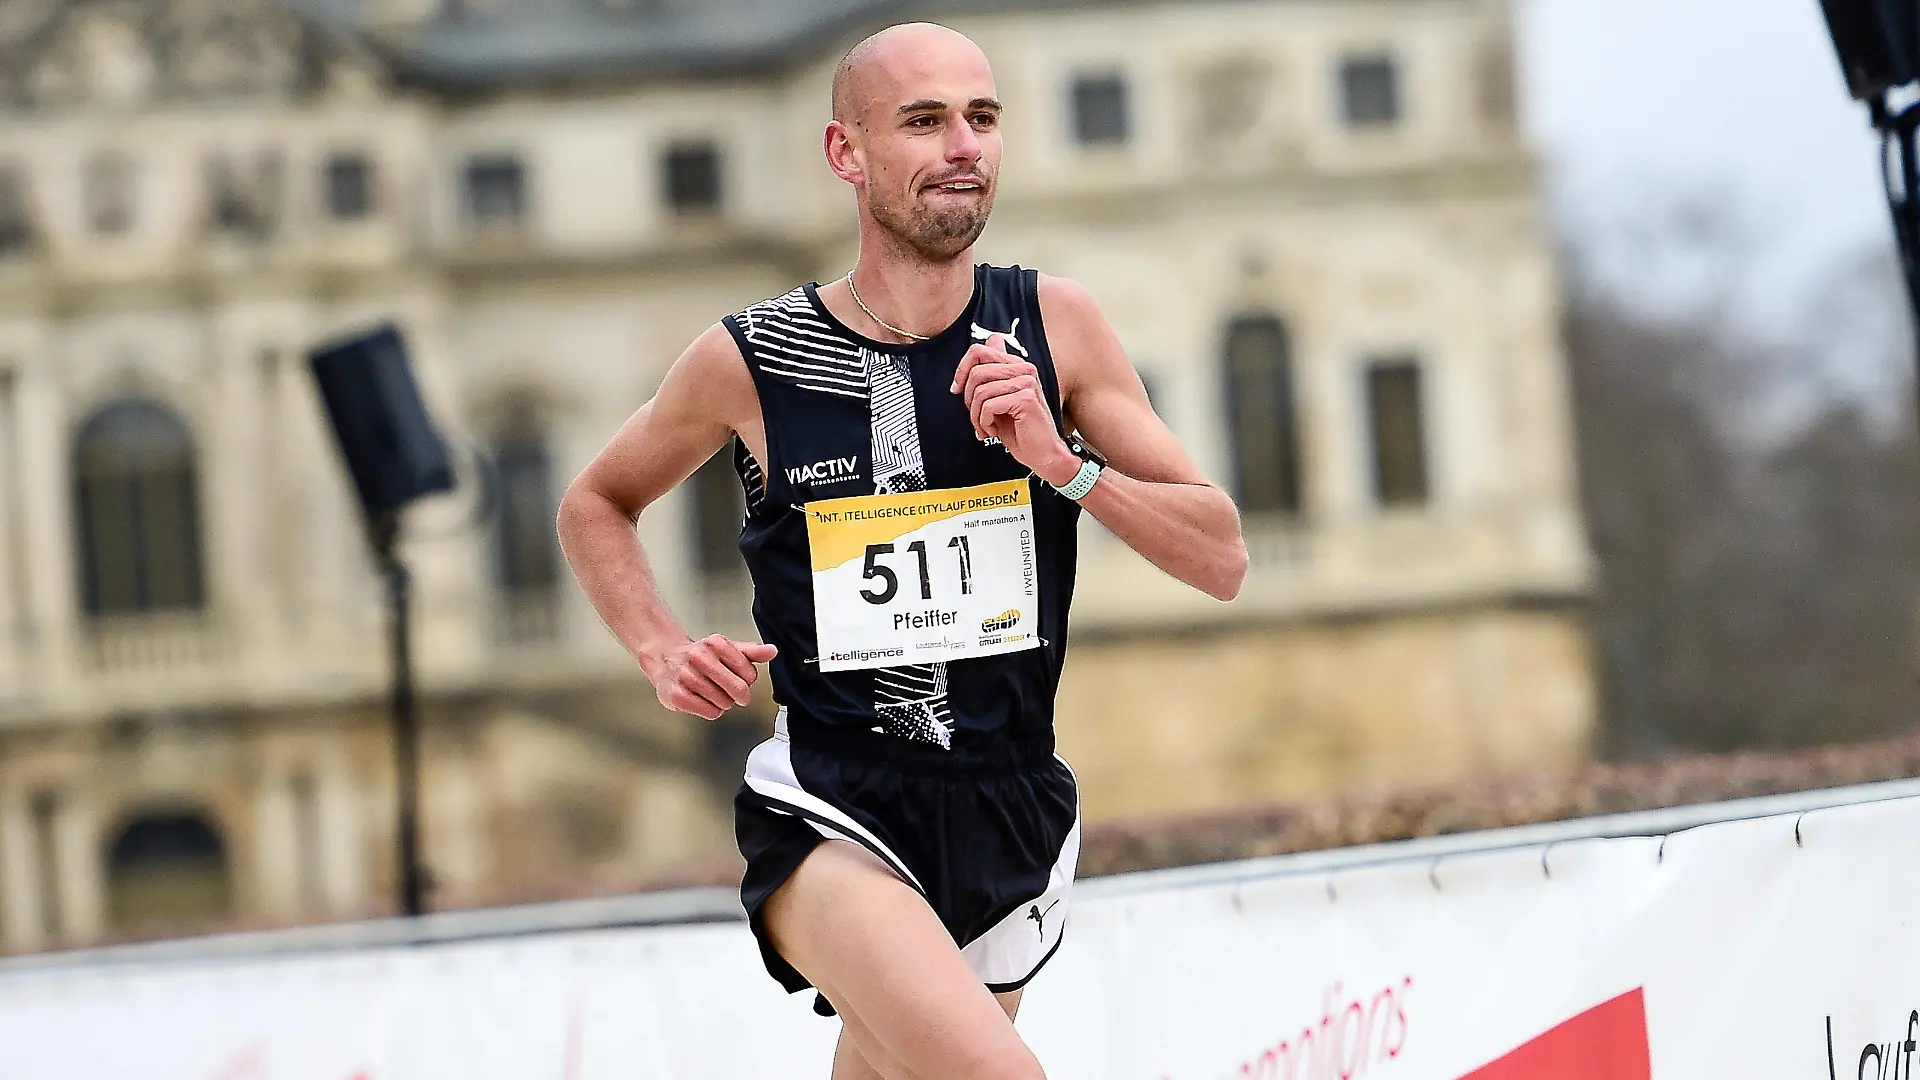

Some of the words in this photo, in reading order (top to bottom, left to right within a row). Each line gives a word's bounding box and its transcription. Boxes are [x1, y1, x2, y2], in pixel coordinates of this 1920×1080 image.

[785, 455, 857, 484] VIACTIV
[819, 512, 842, 523] INT.
[844, 506, 916, 521] ITELLIGENCE
[918, 500, 966, 516] CITYLAUF
[968, 494, 1017, 508] DRESDEN
[964, 520, 979, 528] Half
[982, 516, 1018, 526] marathon
[1020, 513, 1026, 521] A
[859, 535, 972, 605] 511
[894, 609, 958, 630] Pfeiffer
[831, 649, 904, 661] itelligence
[1825, 1009, 1920, 1080] Lauf
